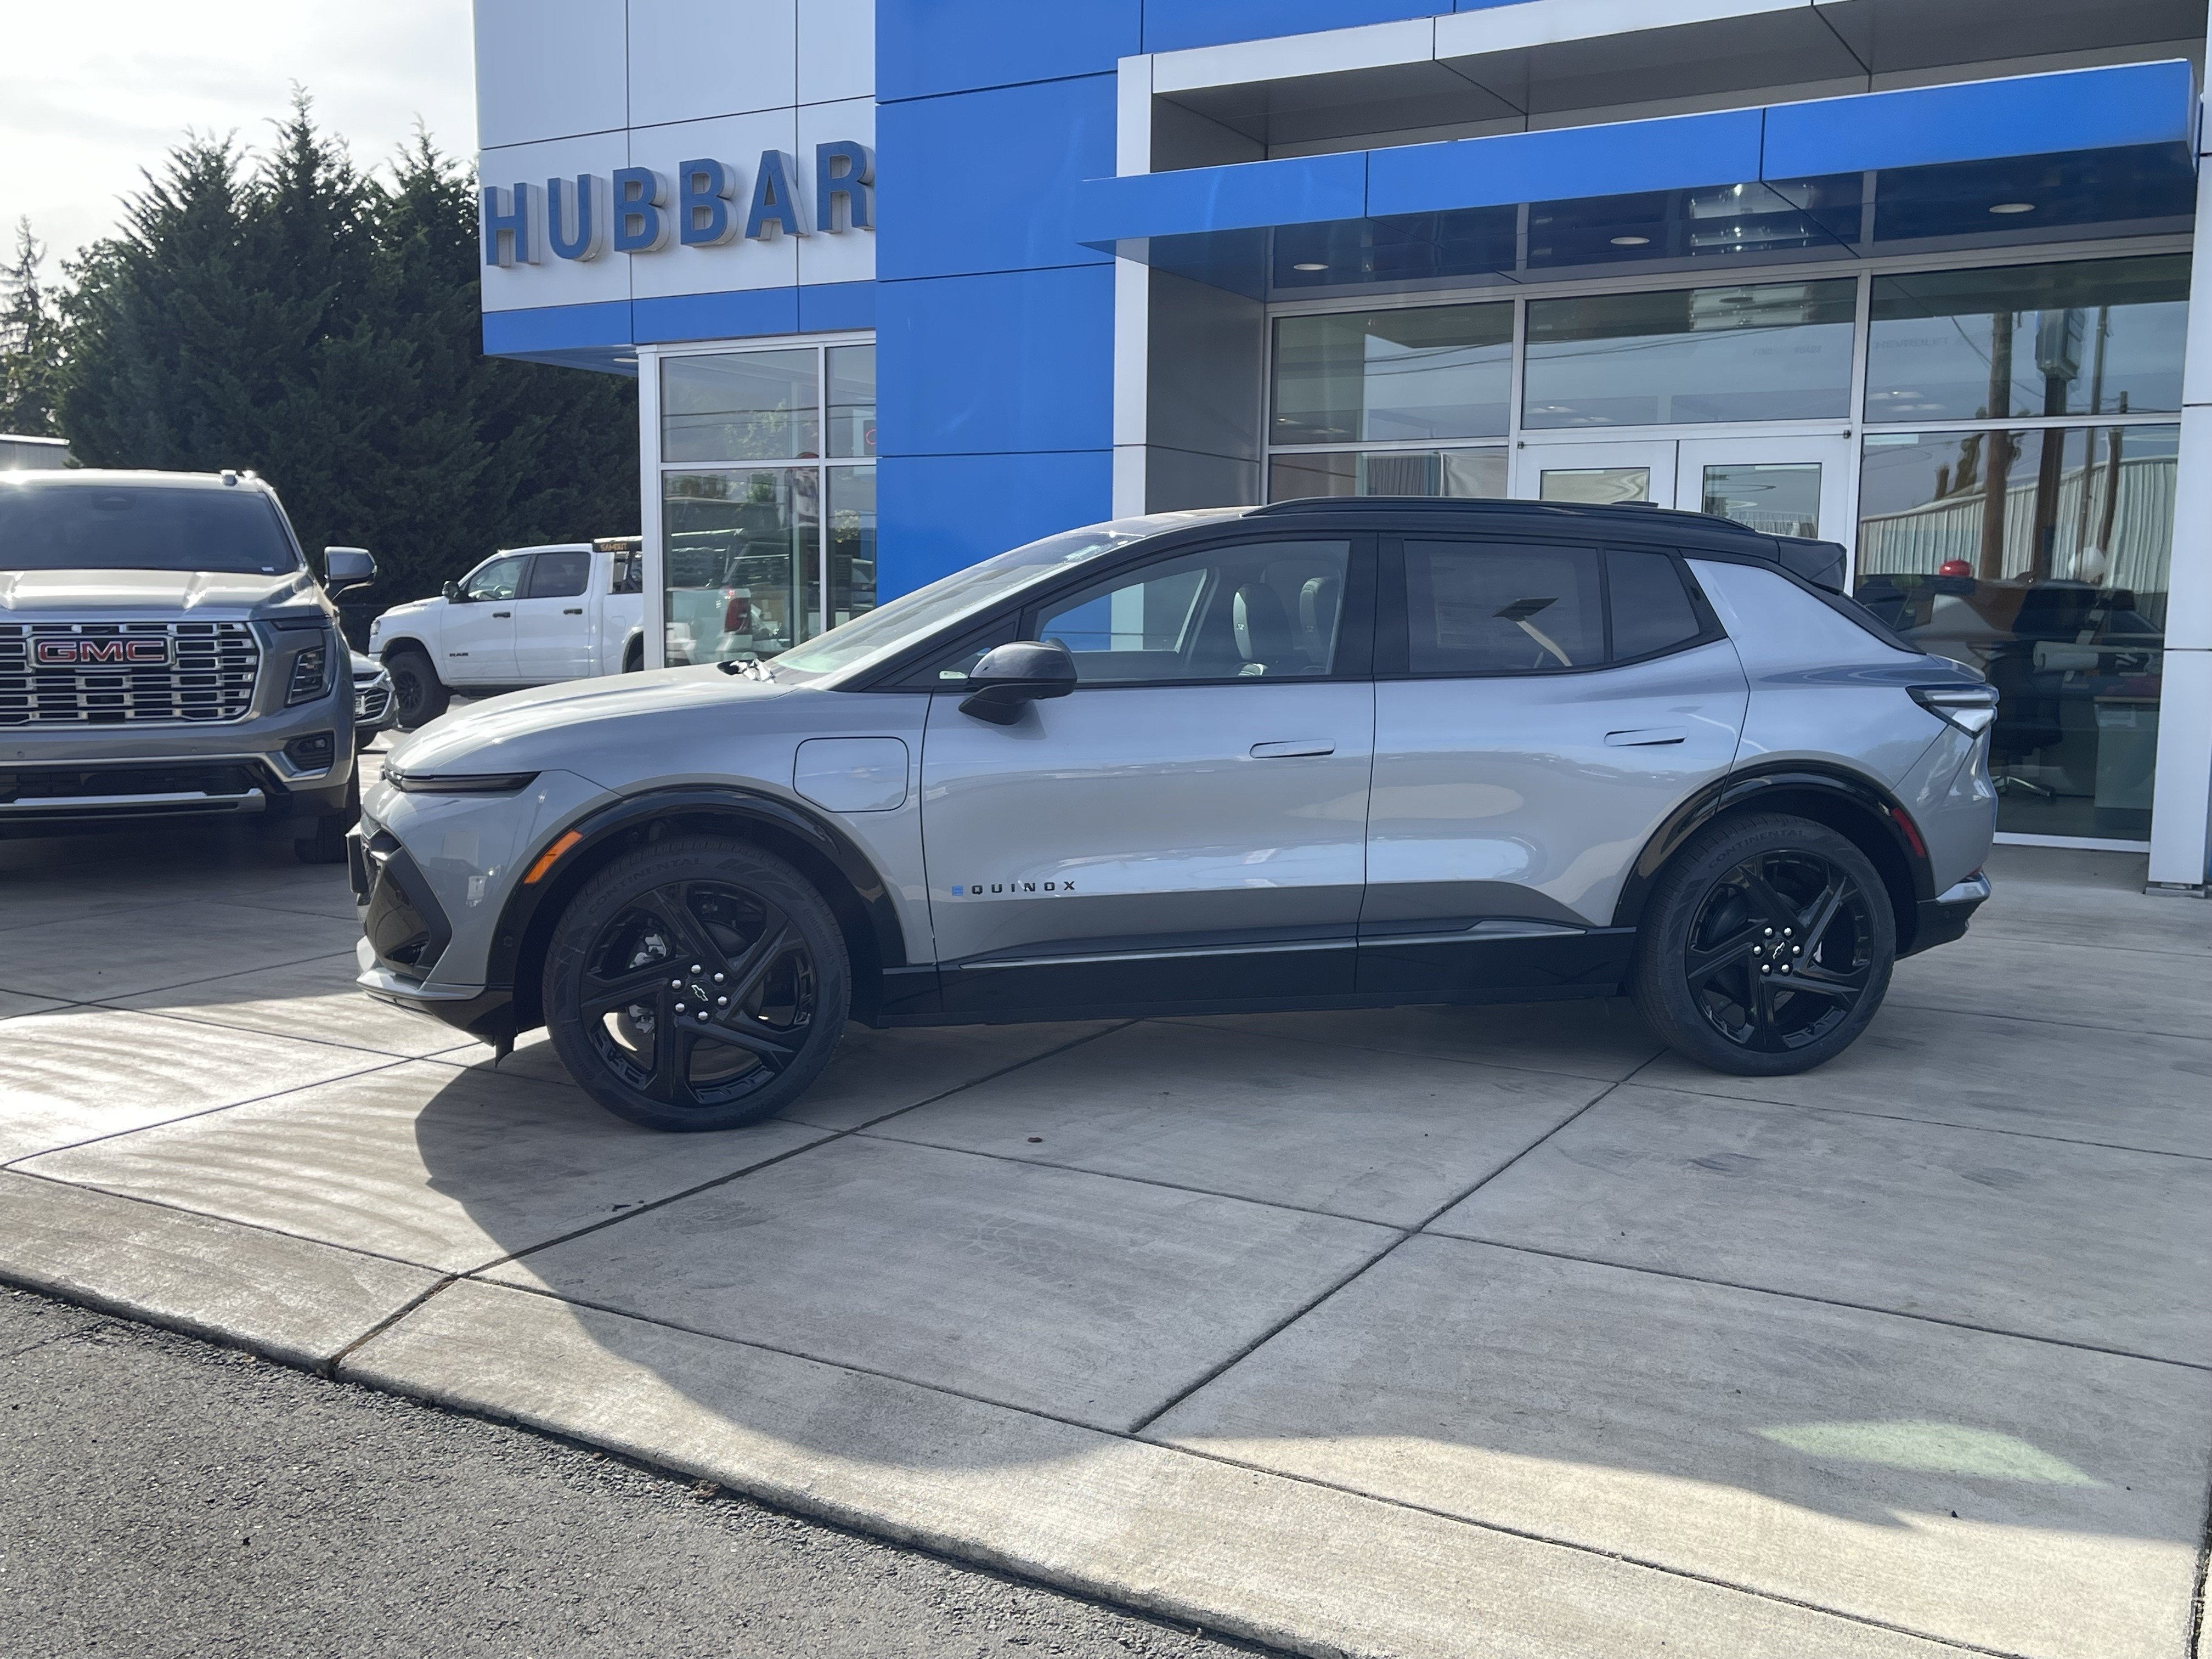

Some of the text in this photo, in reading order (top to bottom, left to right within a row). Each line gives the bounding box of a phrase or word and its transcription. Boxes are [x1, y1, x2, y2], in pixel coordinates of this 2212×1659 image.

[485, 140, 875, 267] HUBBAR
[38, 641, 165, 662] GMC
[1709, 830, 1807, 868] CONTINENTAL
